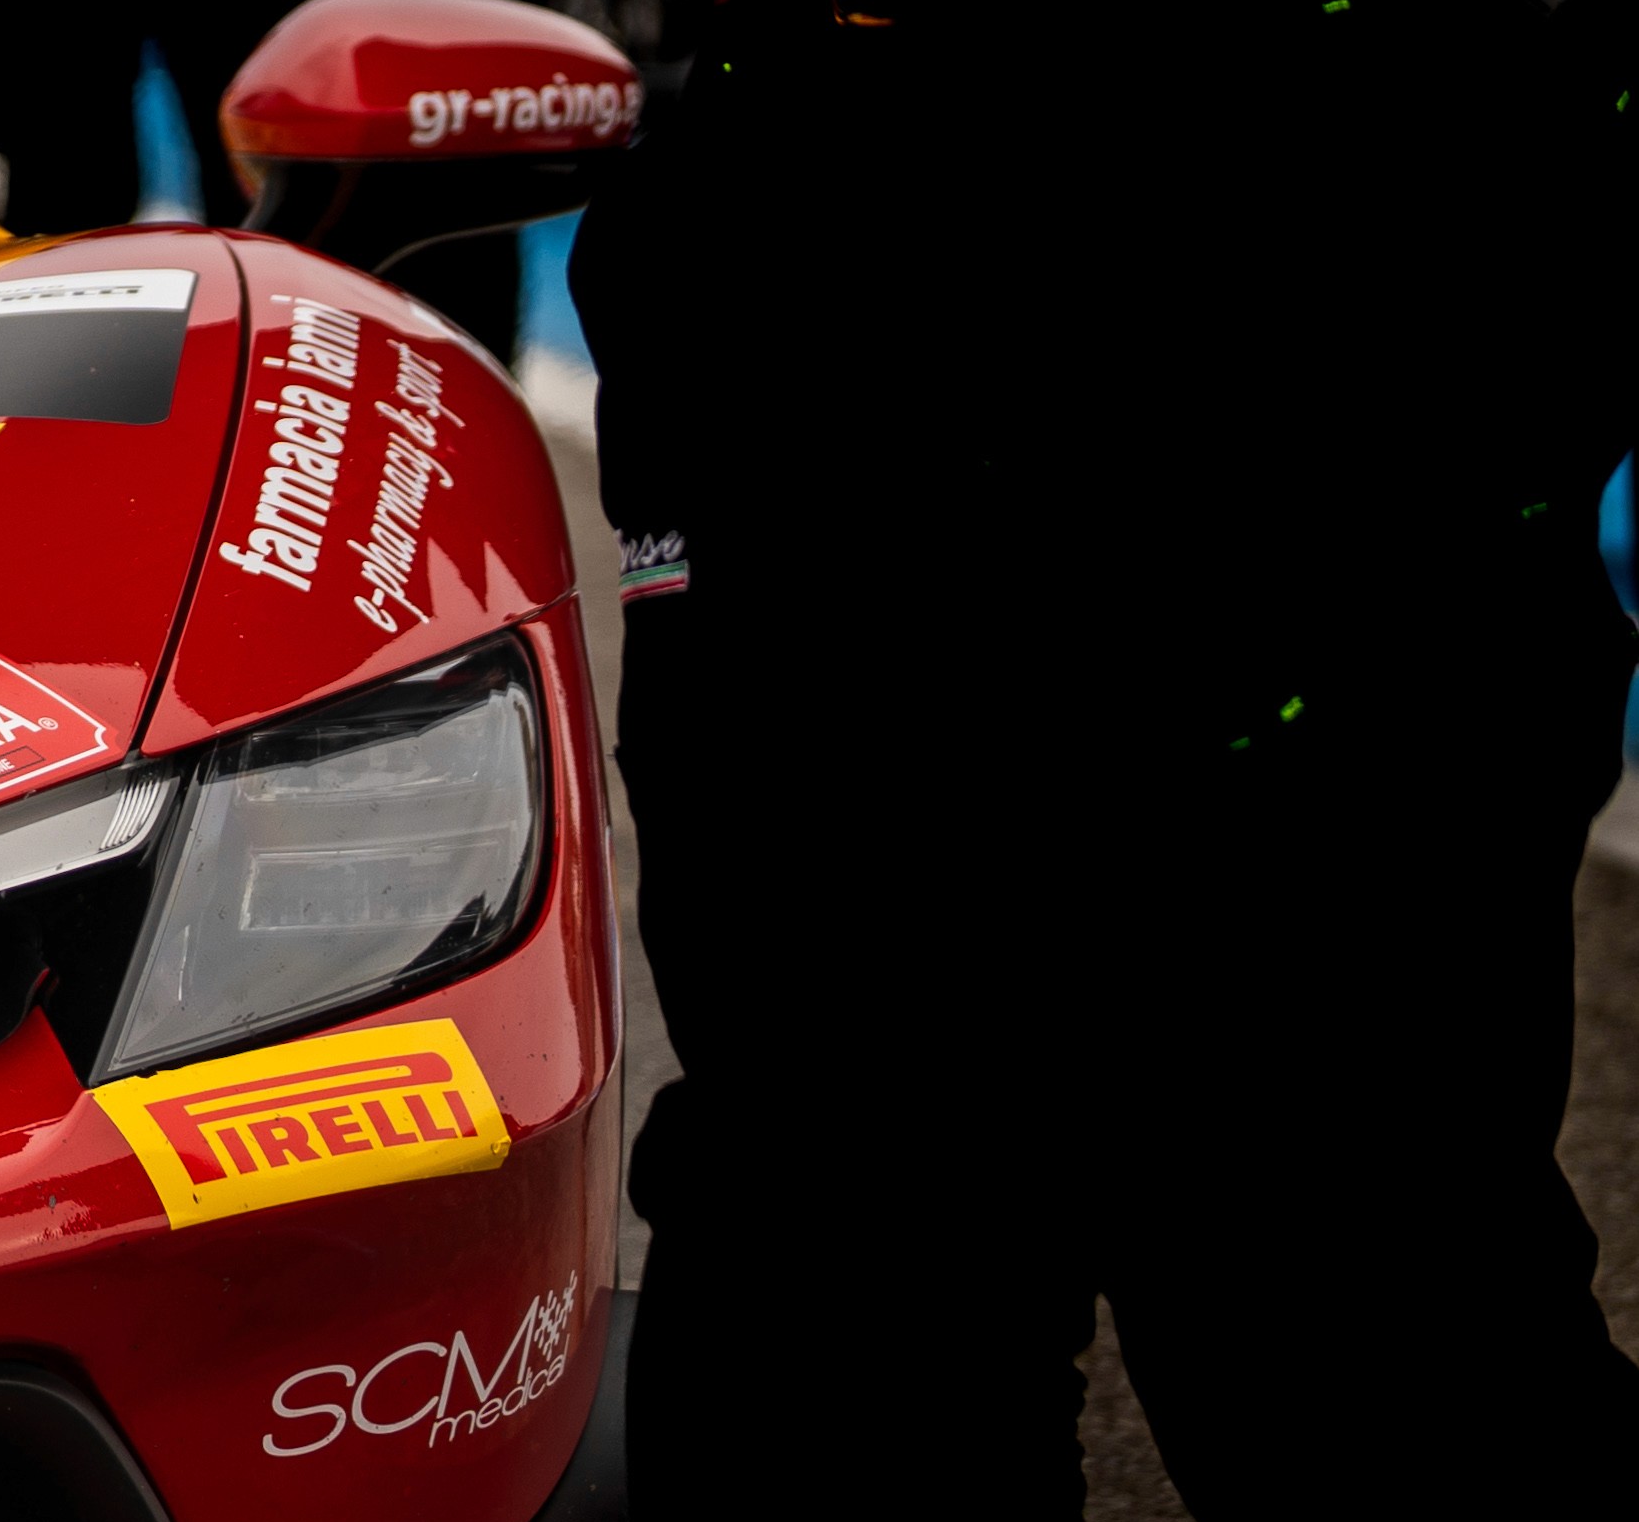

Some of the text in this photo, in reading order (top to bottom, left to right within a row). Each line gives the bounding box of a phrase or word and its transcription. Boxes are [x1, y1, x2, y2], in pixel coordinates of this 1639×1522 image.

[218, 293, 361, 593] farmacia ianni
[346, 337, 467, 633] e-pharmacy & sport
[145, 1051, 479, 1187] PIRELLI
[261, 1294, 540, 1458] SCM
[428, 1333, 570, 1449] medical
